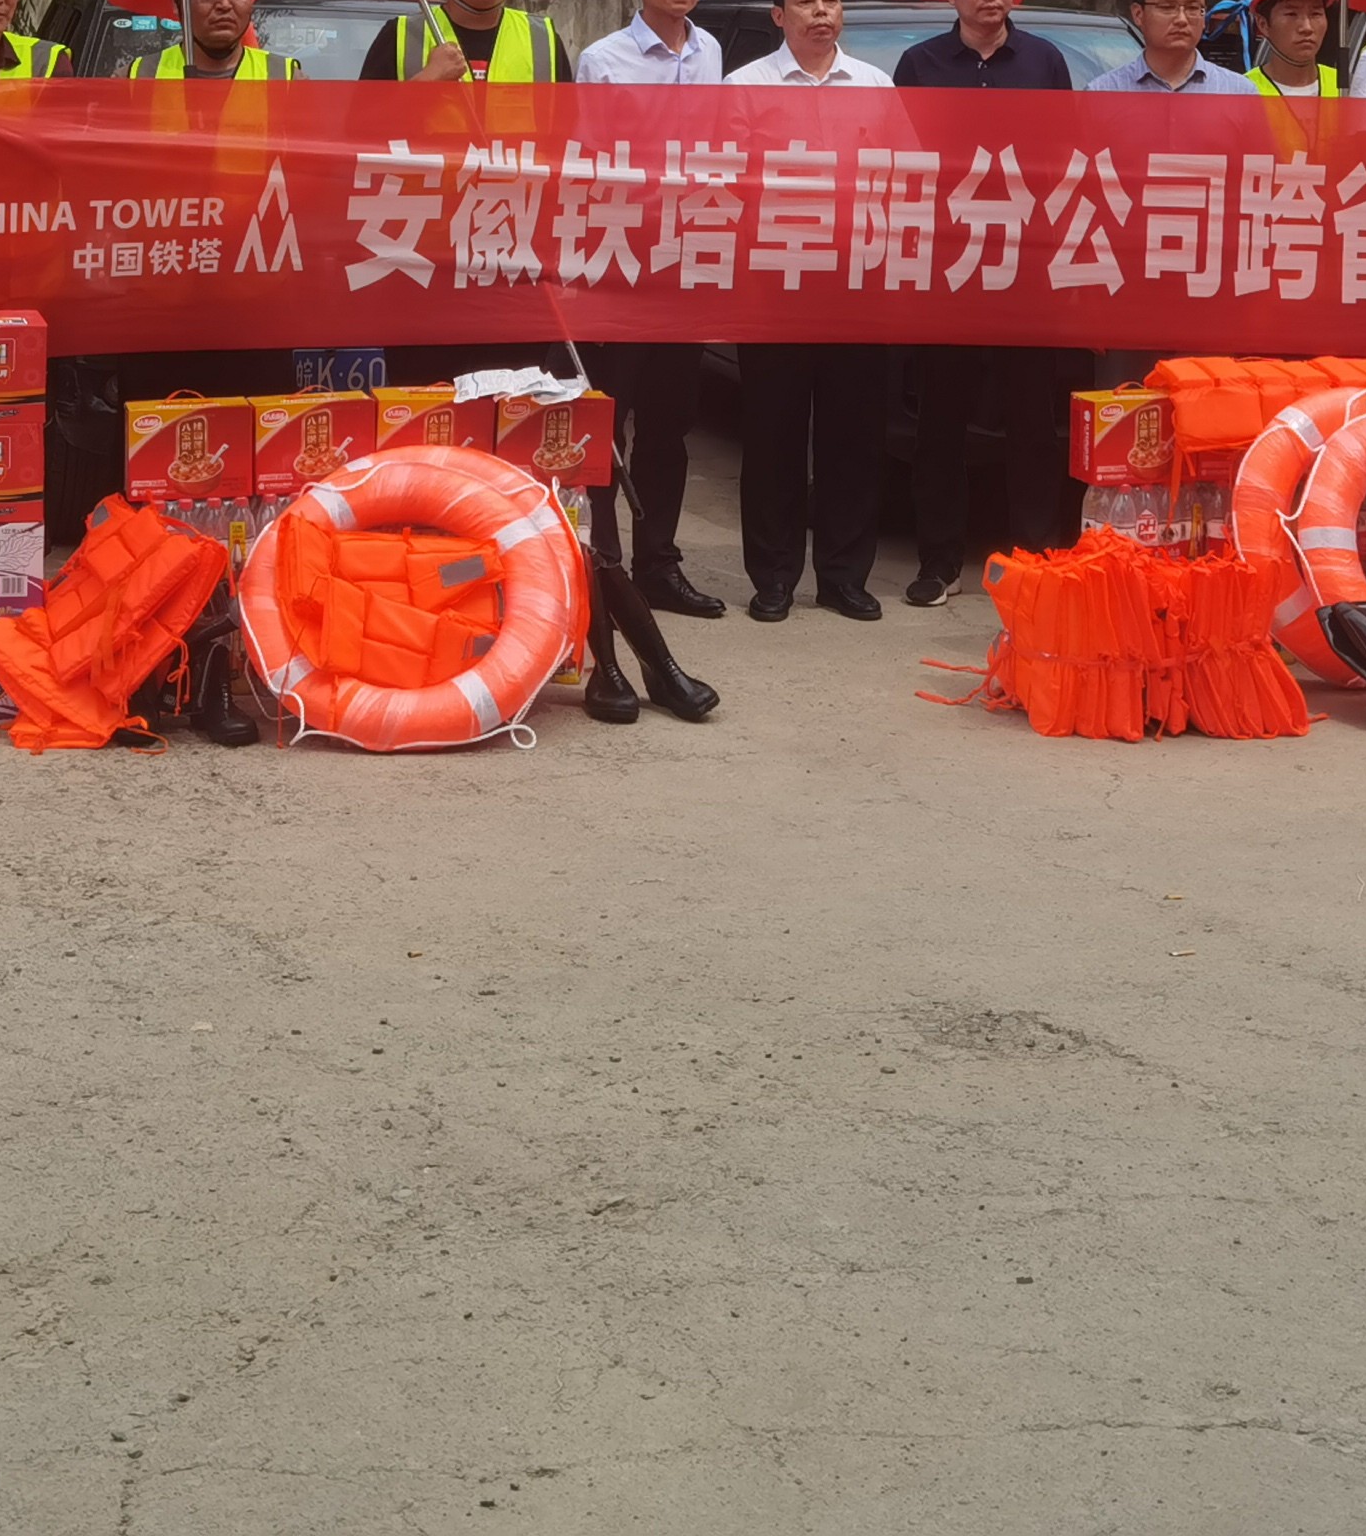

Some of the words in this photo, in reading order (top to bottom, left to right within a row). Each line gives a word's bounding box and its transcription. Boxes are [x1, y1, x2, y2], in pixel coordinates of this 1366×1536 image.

[88, 197, 226, 231] TOWER
[72, 237, 223, 280] 中国铁塔
